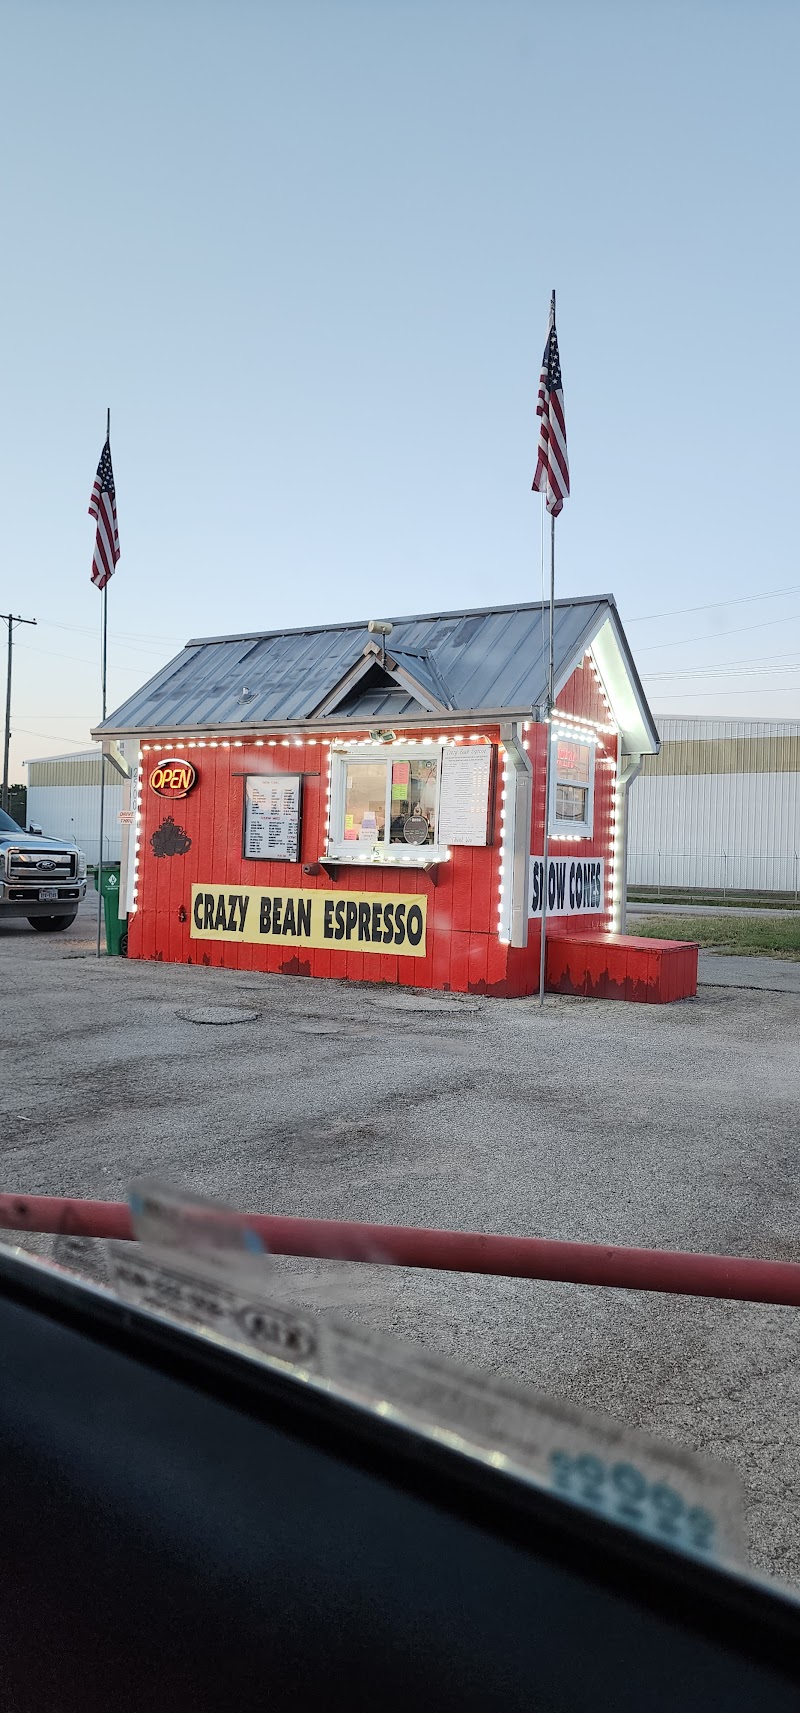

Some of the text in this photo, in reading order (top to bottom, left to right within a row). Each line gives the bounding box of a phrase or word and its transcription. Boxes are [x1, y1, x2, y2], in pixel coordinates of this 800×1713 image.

[151, 769, 192, 788] OPEN
[569, 862, 601, 910] CONES
[193, 893, 423, 946] CRAZY BEAN ESPRESSO
